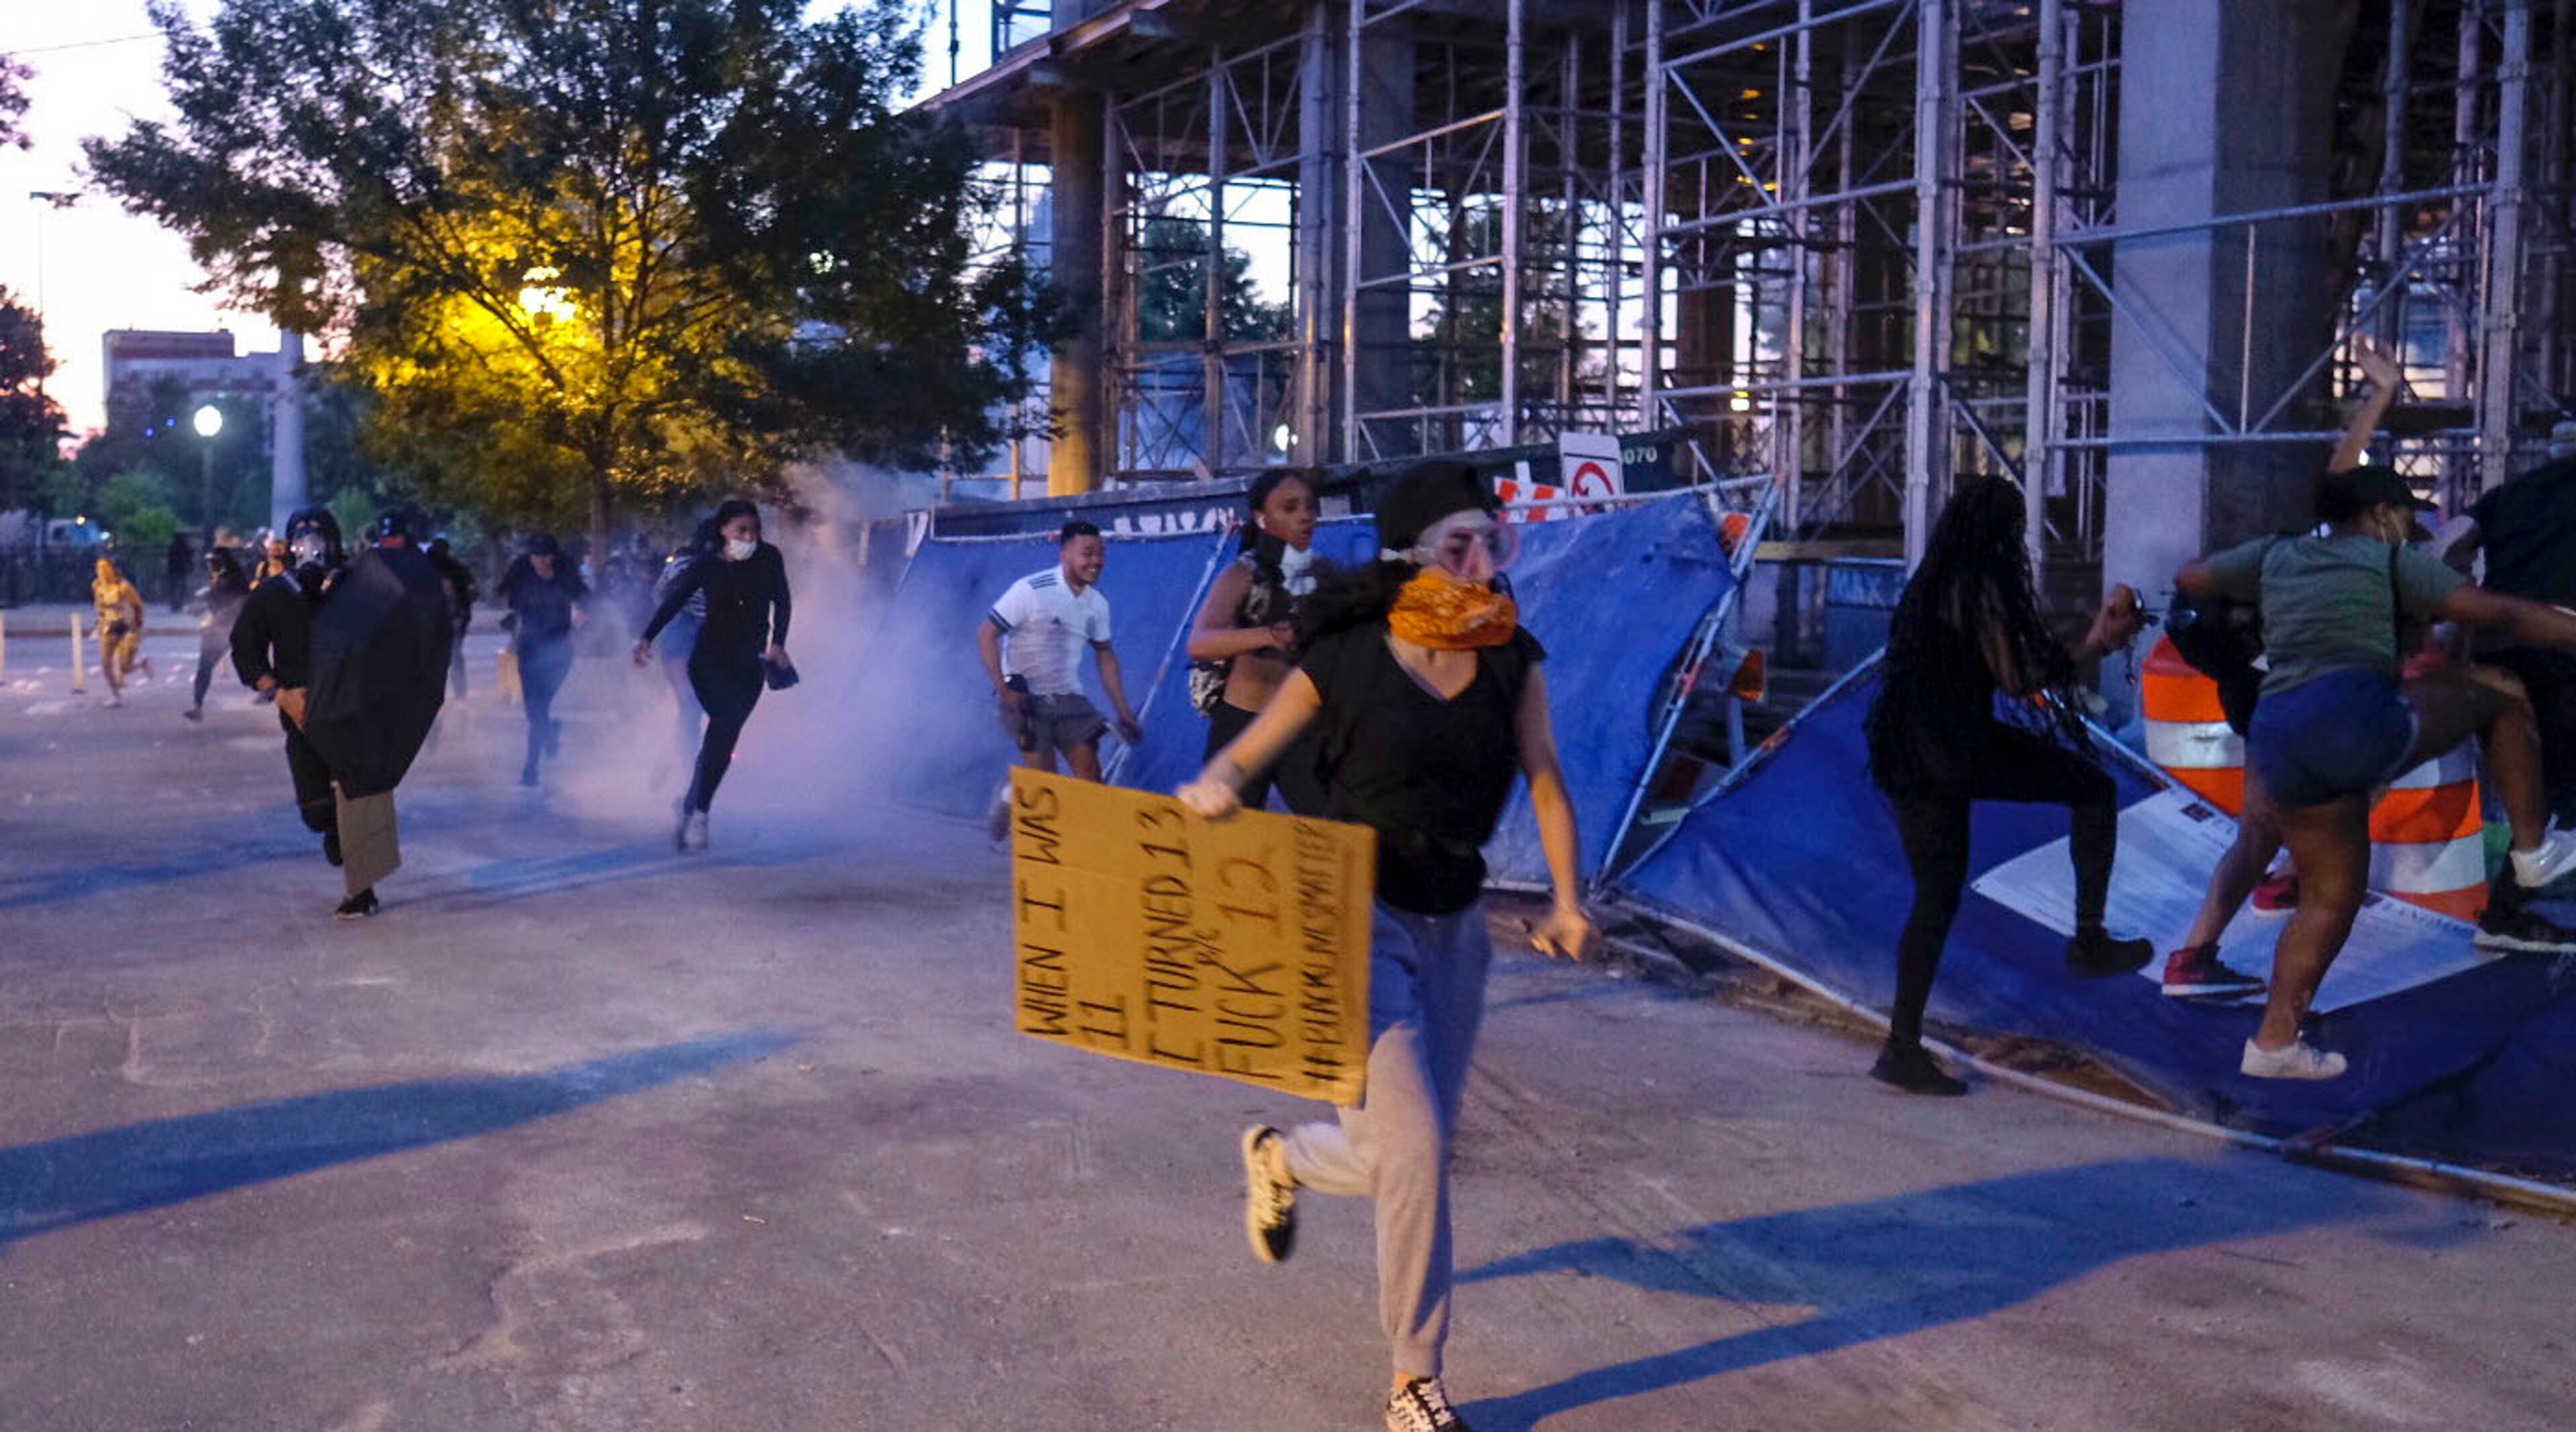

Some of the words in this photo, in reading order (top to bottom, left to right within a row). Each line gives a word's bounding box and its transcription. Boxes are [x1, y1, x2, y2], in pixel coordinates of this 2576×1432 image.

[1016, 785, 1061, 866] WAS
[1136, 807, 1193, 869] 13
[1019, 877, 1067, 933] I
[1142, 874, 1203, 1022] TURNED
[1020, 943, 1071, 1036] WHEN
[1077, 994, 1130, 1050] 11
[1210, 959, 1288, 1079] FUCK
[1148, 1032, 1207, 1068] I
